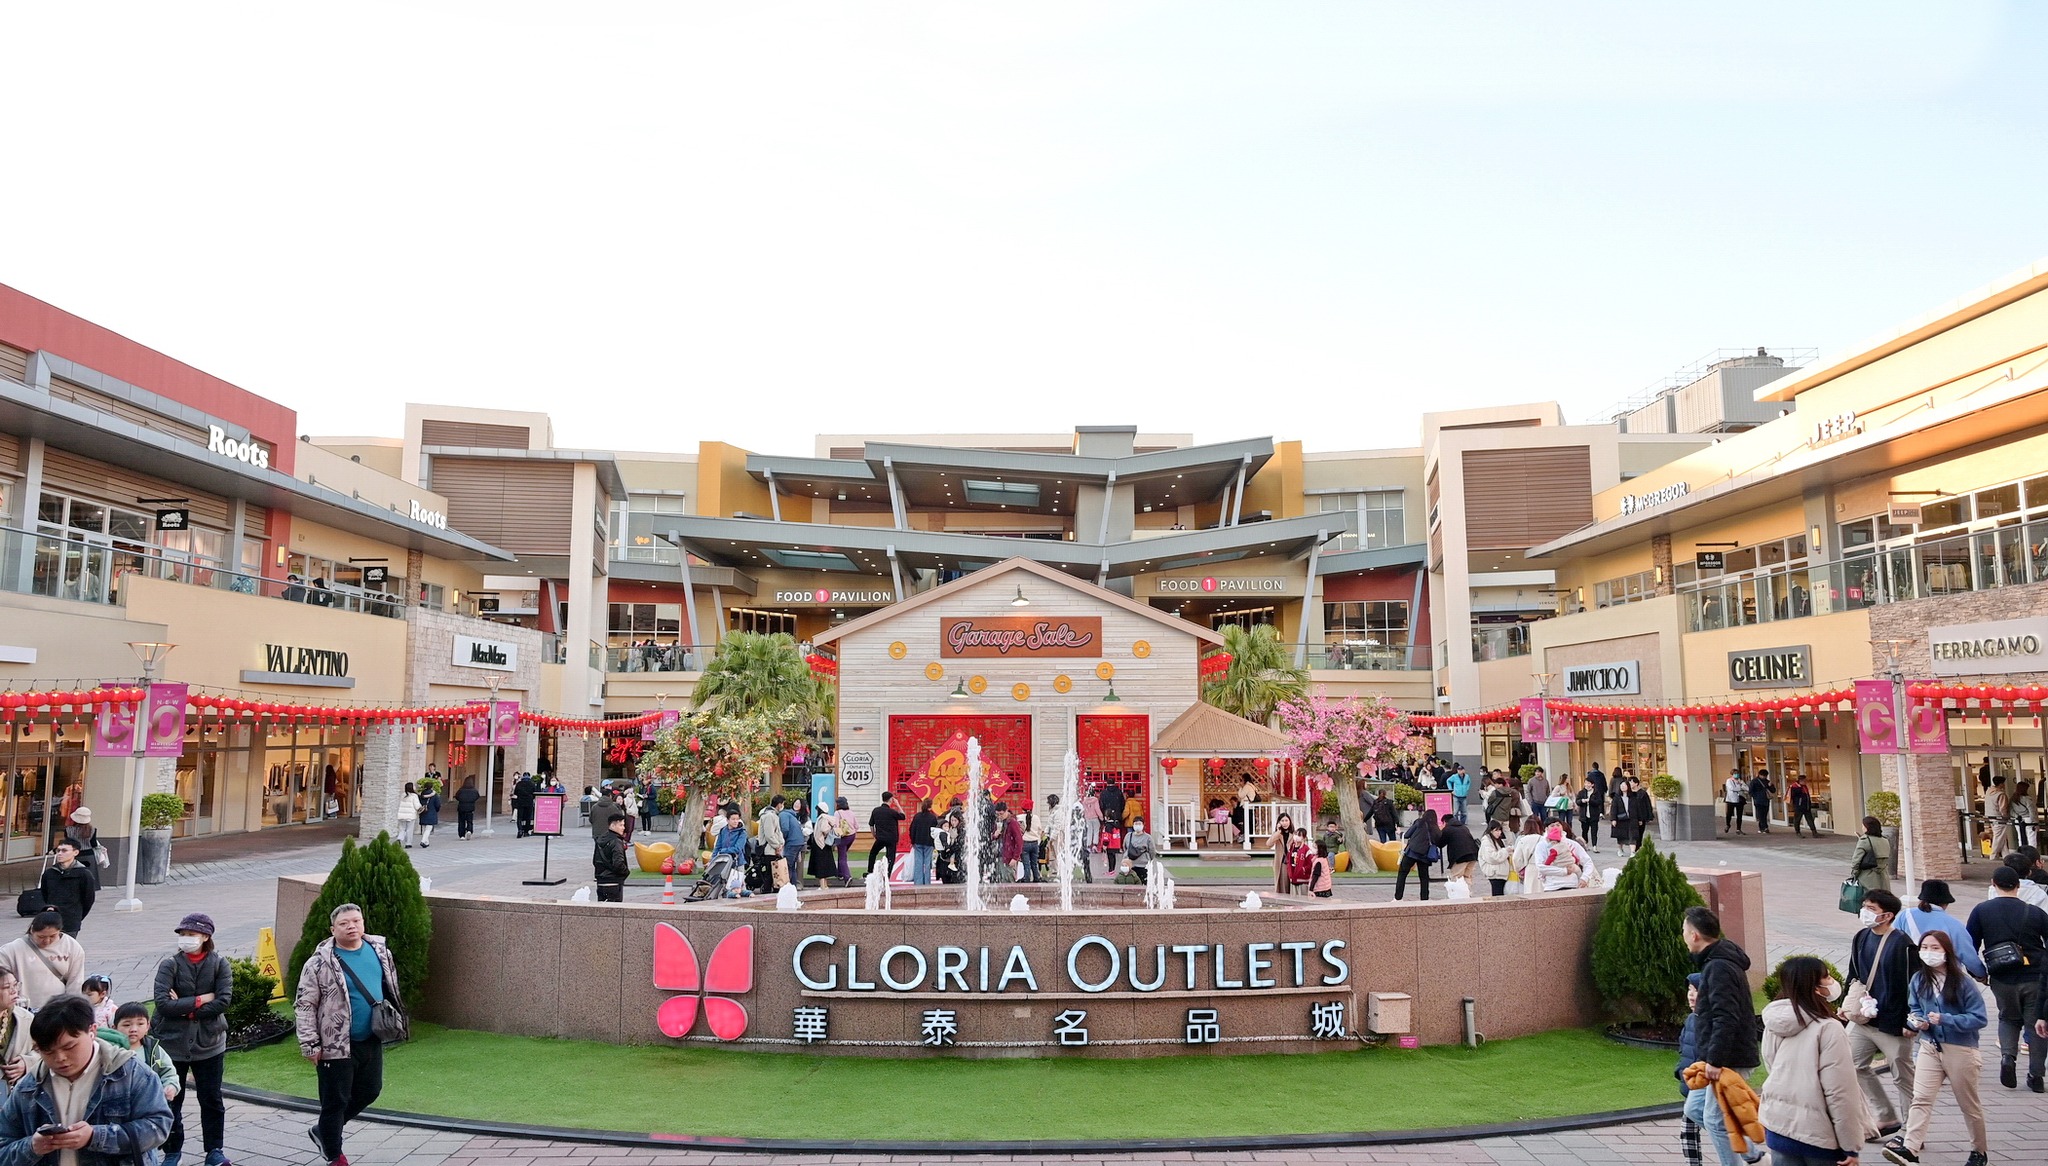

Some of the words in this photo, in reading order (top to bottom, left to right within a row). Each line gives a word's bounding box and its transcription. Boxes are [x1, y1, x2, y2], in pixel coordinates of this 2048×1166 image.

[206, 424, 269, 469] Roots
[408, 499, 447, 530] Roots
[776, 591, 812, 602] FOOD
[832, 591, 891, 601] PAVILION
[1160, 580, 1199, 591] FOOD
[1220, 580, 1283, 590] PAVILION
[948, 621, 1026, 654] Garage
[1026, 622, 1093, 650] Sale
[1932, 634, 2040, 660] FERRAGAMO
[264, 643, 349, 678] VALENTINO
[1731, 653, 1801, 681] CELINE
[846, 770, 870, 781] 2015
[792, 934, 1040, 992] GLORIA
[1066, 934, 1350, 992] OUTLETS
[792, 1001, 1346, 1046] 華泰名品城
